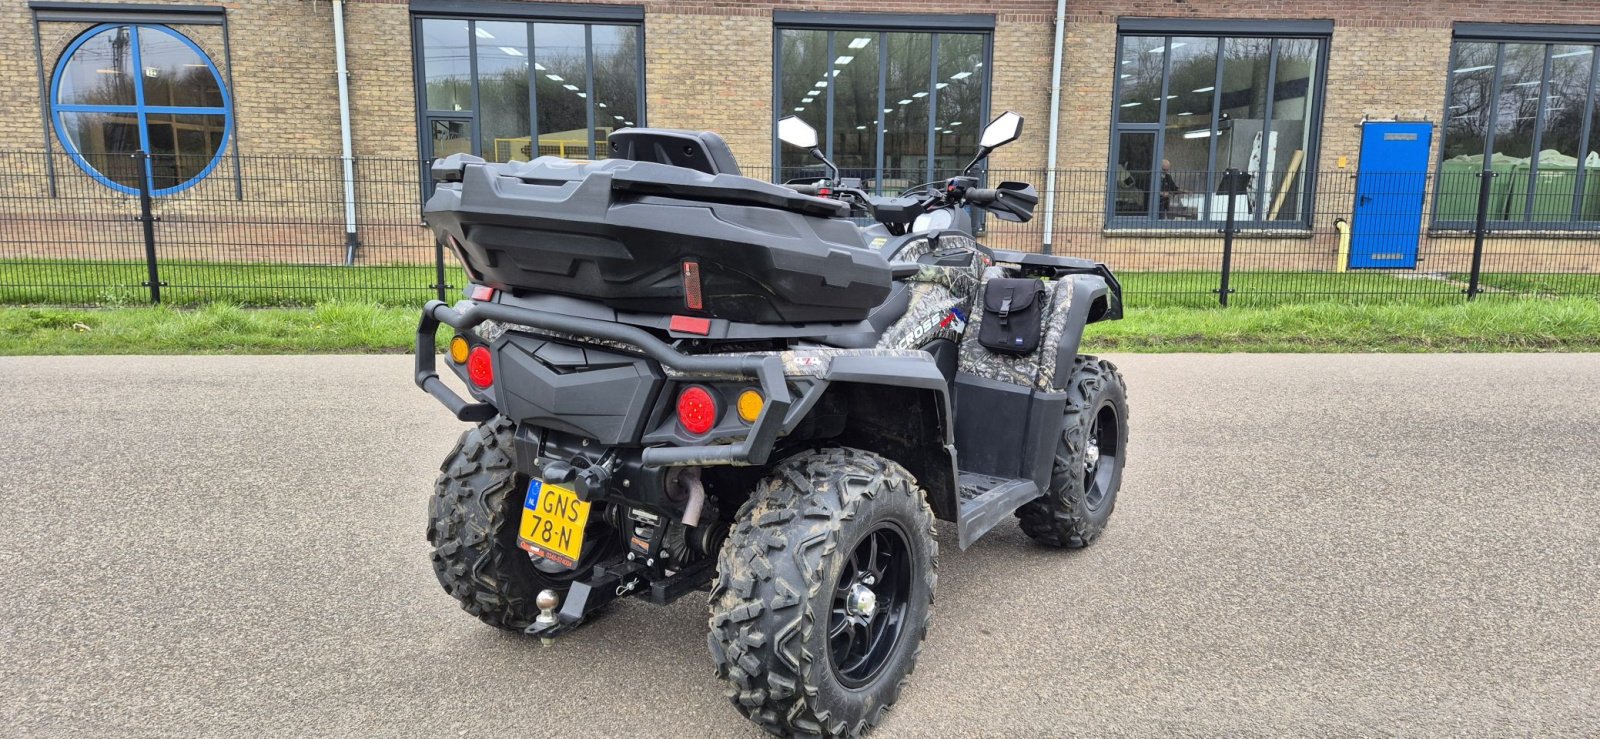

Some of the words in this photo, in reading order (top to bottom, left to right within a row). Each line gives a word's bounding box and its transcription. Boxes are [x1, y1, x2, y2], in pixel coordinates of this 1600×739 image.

[896, 312, 940, 350] CROSS
[528, 497, 535, 507] NL
[543, 490, 581, 523] GNS
[530, 514, 572, 551] 78-N
